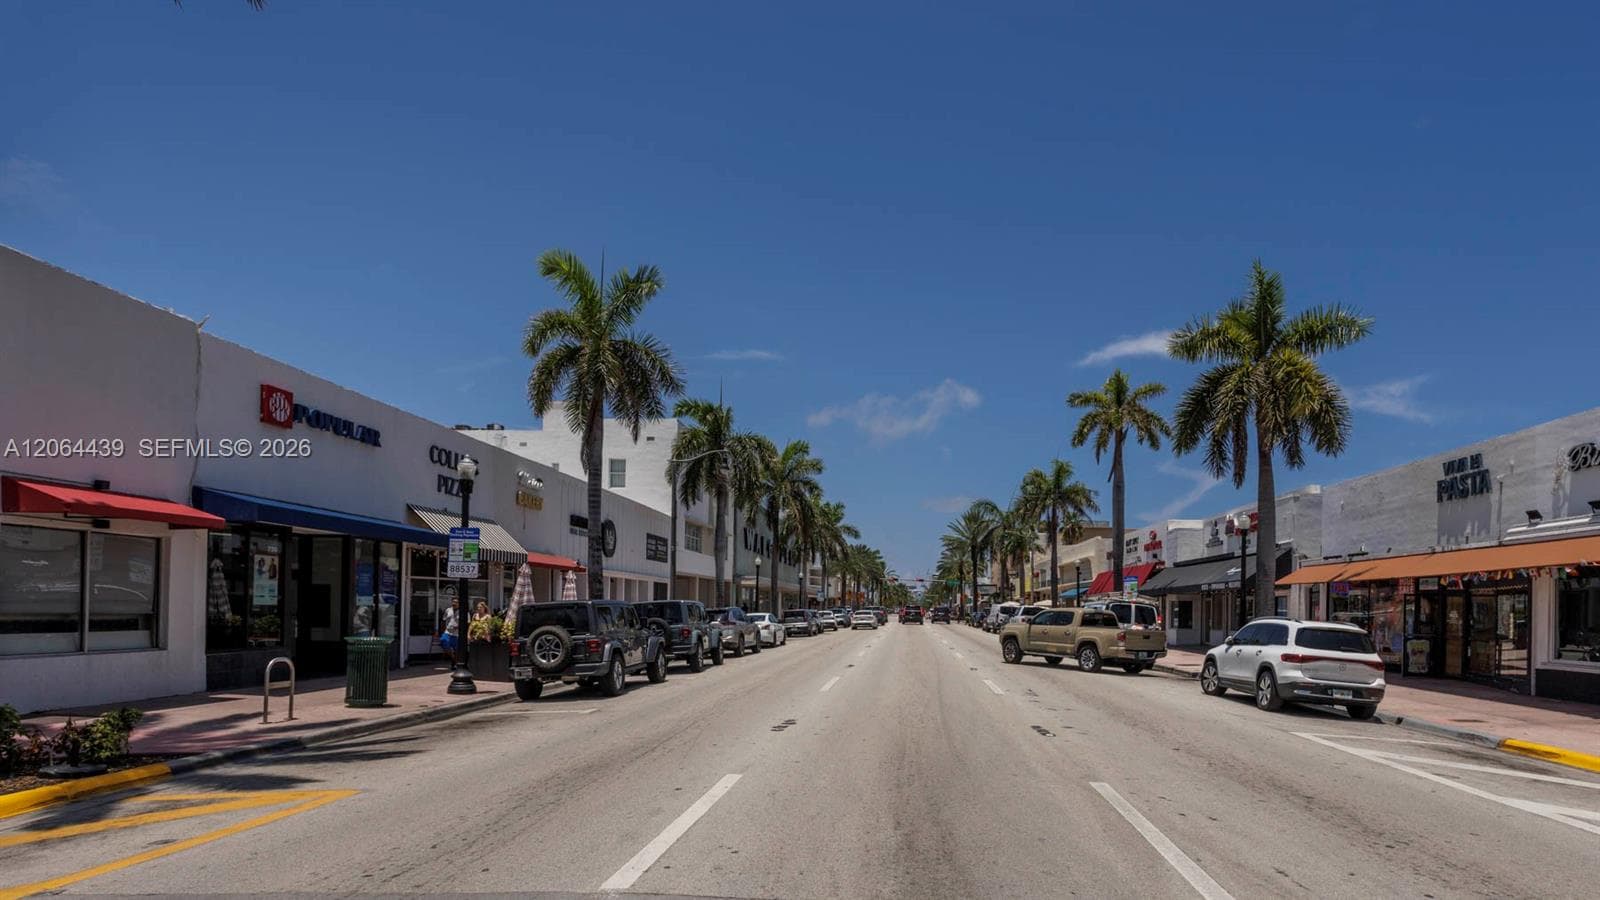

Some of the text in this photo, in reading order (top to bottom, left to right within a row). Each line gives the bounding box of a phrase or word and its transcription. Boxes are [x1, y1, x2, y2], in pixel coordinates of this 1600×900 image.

[294, 403, 382, 447] POPULAR
[429, 444, 479, 476] COLL
[437, 474, 473, 497] PIZZ
[1437, 469, 1493, 503] PASTA
[449, 564, 477, 574] 88537
